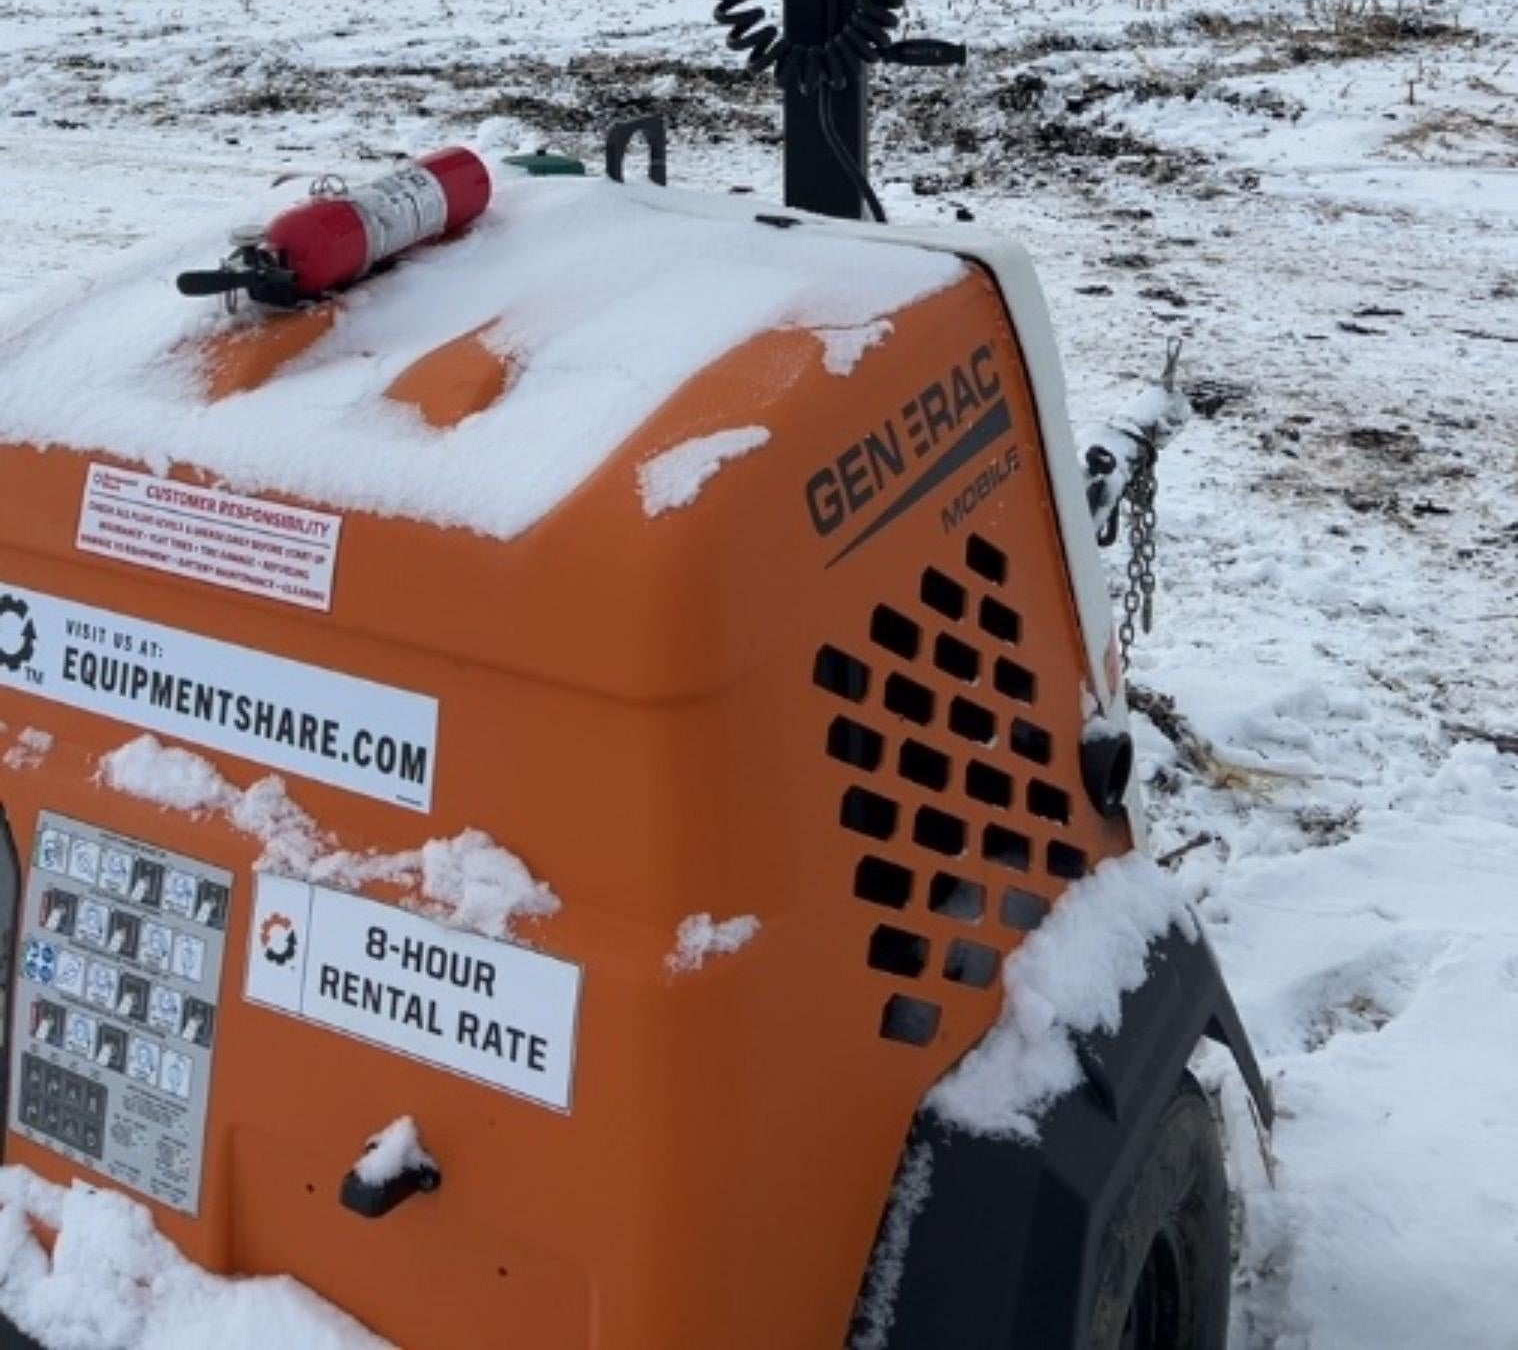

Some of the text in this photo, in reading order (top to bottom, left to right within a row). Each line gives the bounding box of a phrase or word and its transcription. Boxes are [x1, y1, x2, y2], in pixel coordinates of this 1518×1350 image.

[805, 343, 1001, 538] GENERAC
[145, 484, 331, 538] CUSTOMER RESPONSIBILITY
[940, 446, 1021, 534] MOBILE
[65, 617, 164, 659] VISIT US AT:
[62, 646, 428, 785] EQUIPMENTSHARE.COM
[365, 925, 497, 998] 8-HOUR
[319, 963, 549, 1073] RENTAL RATE
